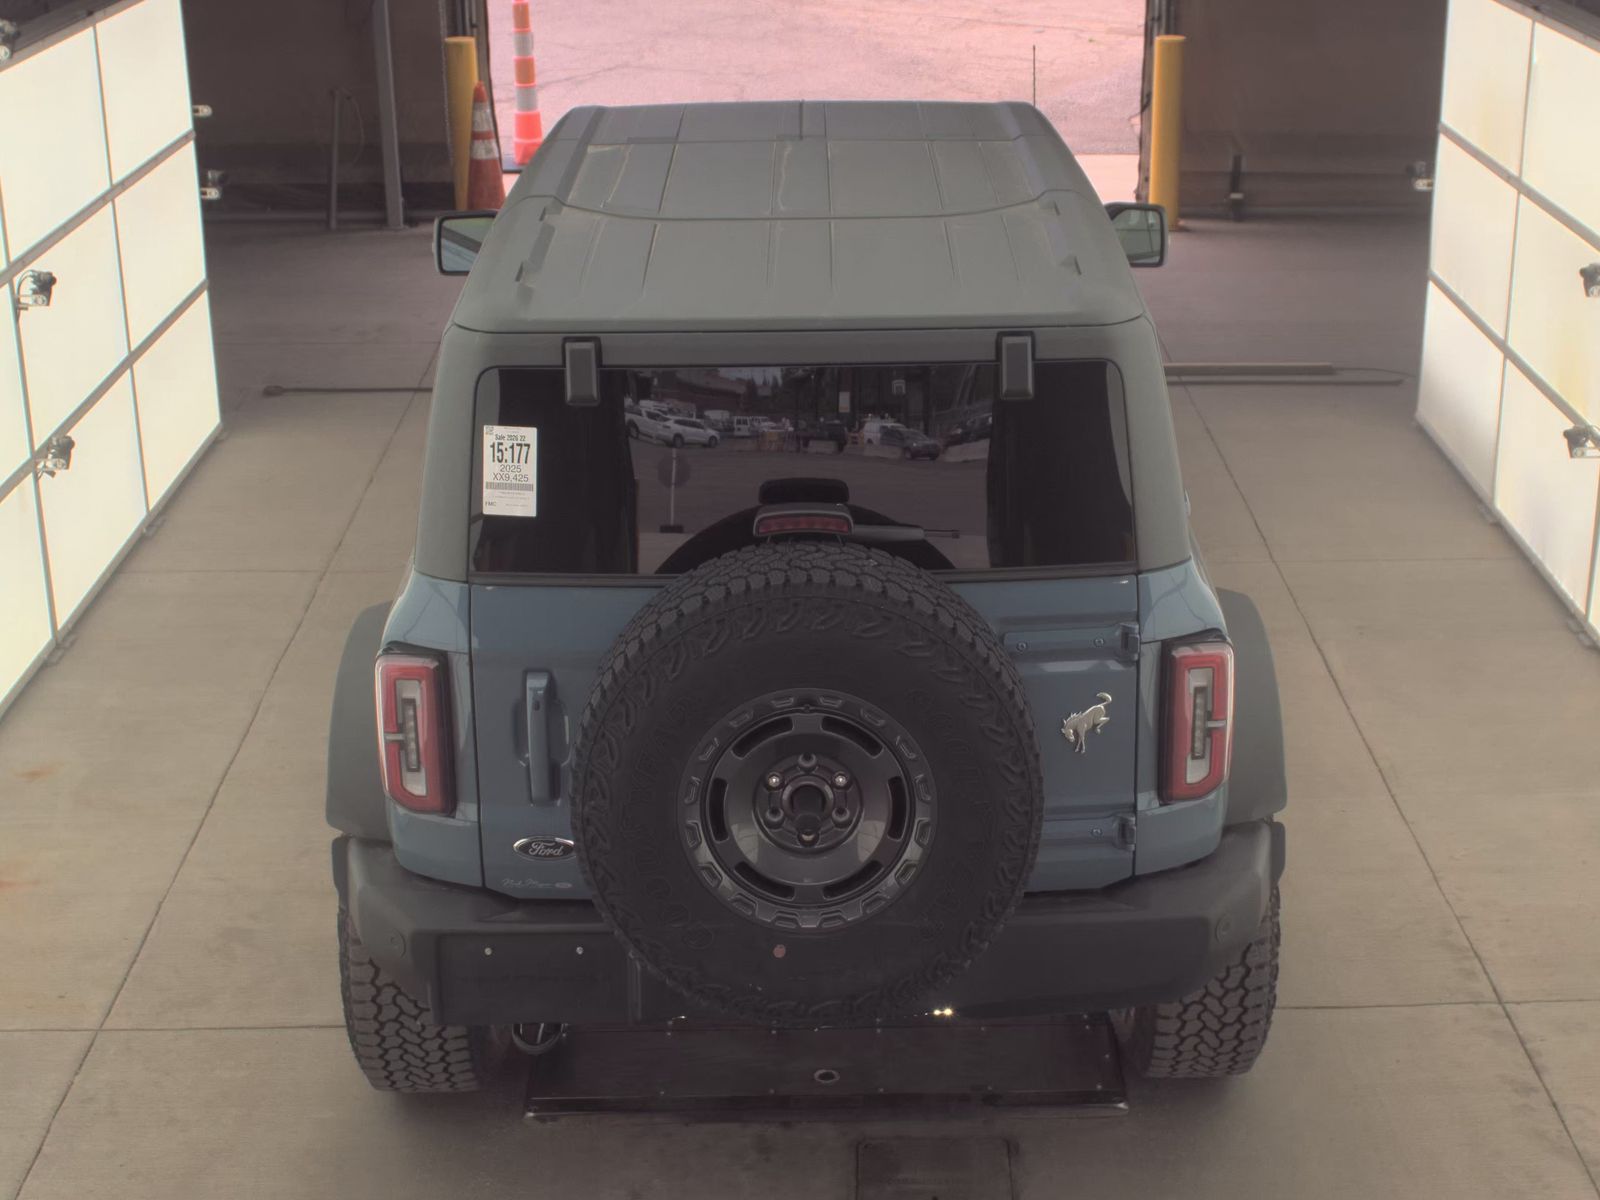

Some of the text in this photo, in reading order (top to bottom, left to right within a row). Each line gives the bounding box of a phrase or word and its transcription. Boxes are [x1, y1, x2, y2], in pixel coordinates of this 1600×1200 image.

[495, 433, 506, 441] Sale
[489, 441, 531, 464] 15:177
[499, 464, 522, 473] 2025
[528, 841, 564, 856] Ford
